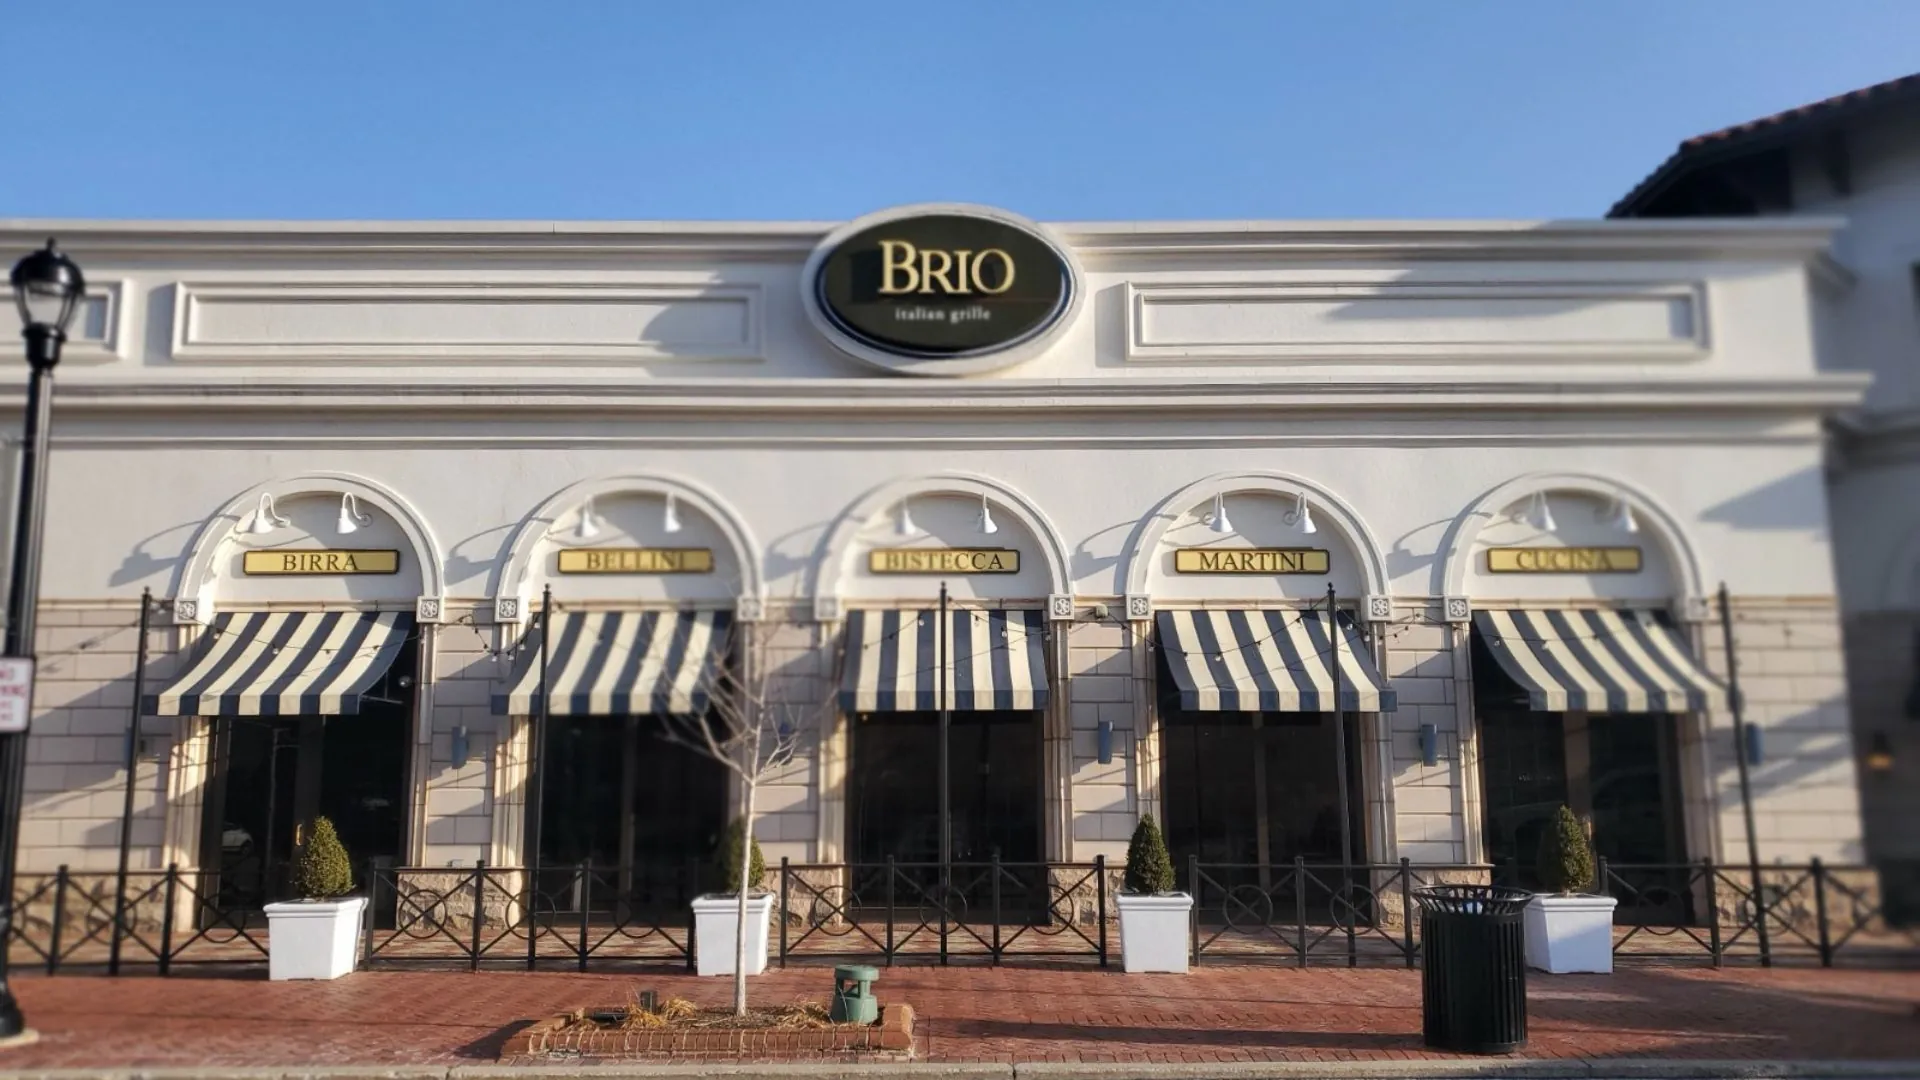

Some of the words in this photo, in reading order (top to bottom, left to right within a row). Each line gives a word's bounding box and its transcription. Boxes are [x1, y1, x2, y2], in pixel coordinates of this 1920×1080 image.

[878, 241, 1015, 294] BRIO
[895, 306, 945, 320] italian
[950, 305, 990, 324] grille
[283, 554, 359, 571] BIRRA
[587, 552, 685, 570] BELLINI
[886, 552, 1004, 570] BISTECCA
[1198, 552, 1305, 570] MARTINI
[1516, 551, 1614, 570] CUCINA
